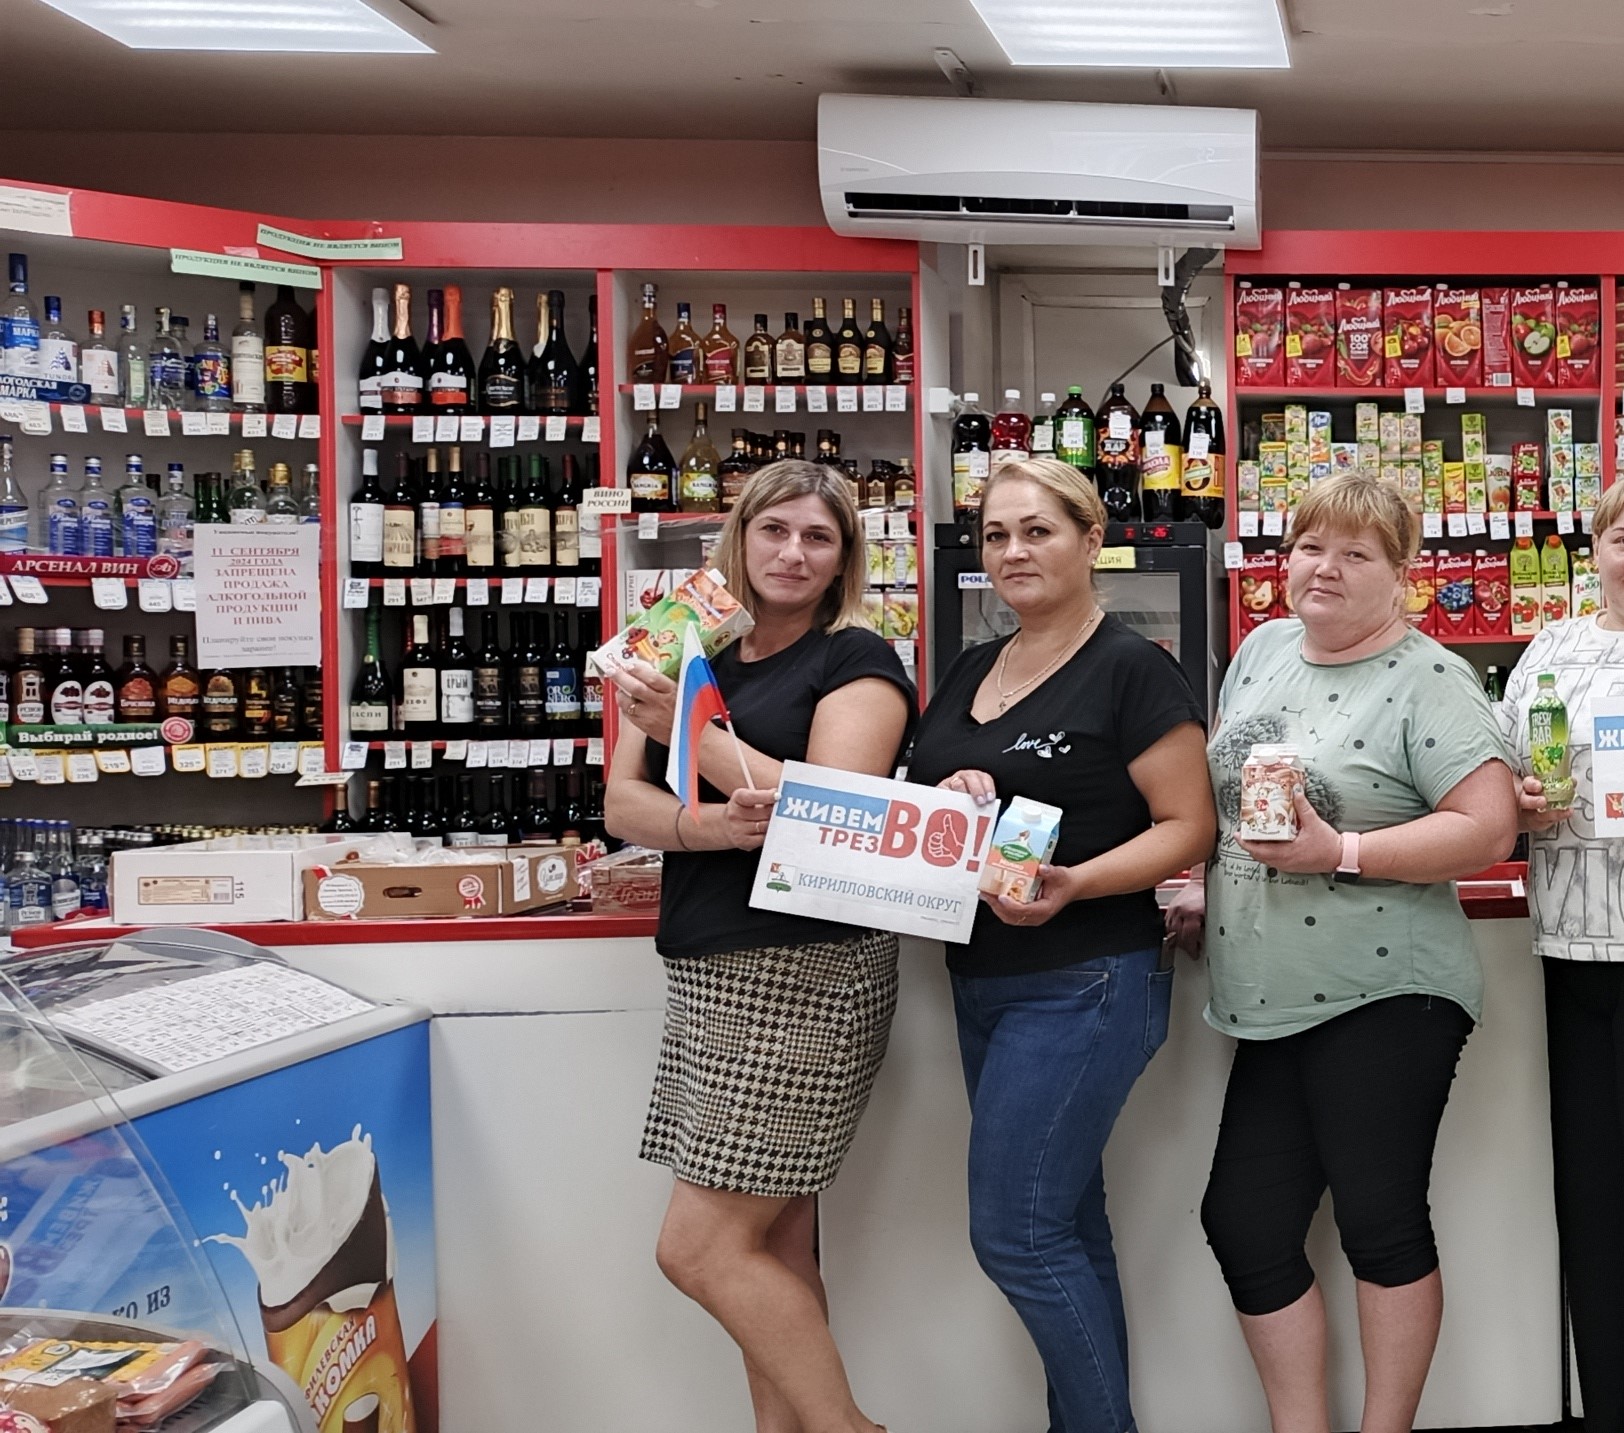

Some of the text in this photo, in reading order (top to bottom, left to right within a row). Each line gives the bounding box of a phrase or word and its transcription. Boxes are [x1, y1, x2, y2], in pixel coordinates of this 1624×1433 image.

[230, 548, 299, 556] СЕНТЯБРЯ
[12, 560, 139, 575] АРСЕНАЛ ВИН
[254, 558, 283, 566] ГОДА
[215, 569, 297, 577] ЗАПРЕЩЕНА
[224, 581, 289, 589] ПРОДАЖА
[206, 591, 307, 602] АЛКОГОЛЬНОЙ
[216, 604, 298, 614] ПРОДУКЦИИ
[247, 617, 282, 625] ПИВА
[1531, 711, 1552, 728] FRESH
[18, 730, 159, 744] Выбирай родное!
[1532, 727, 1552, 745] BAR
[782, 796, 885, 833] ЖИВЕМ
[234, 881, 244, 900] 115
[798, 873, 962, 914] КИРИЛЛОВСКИЙ ОКРУГ
